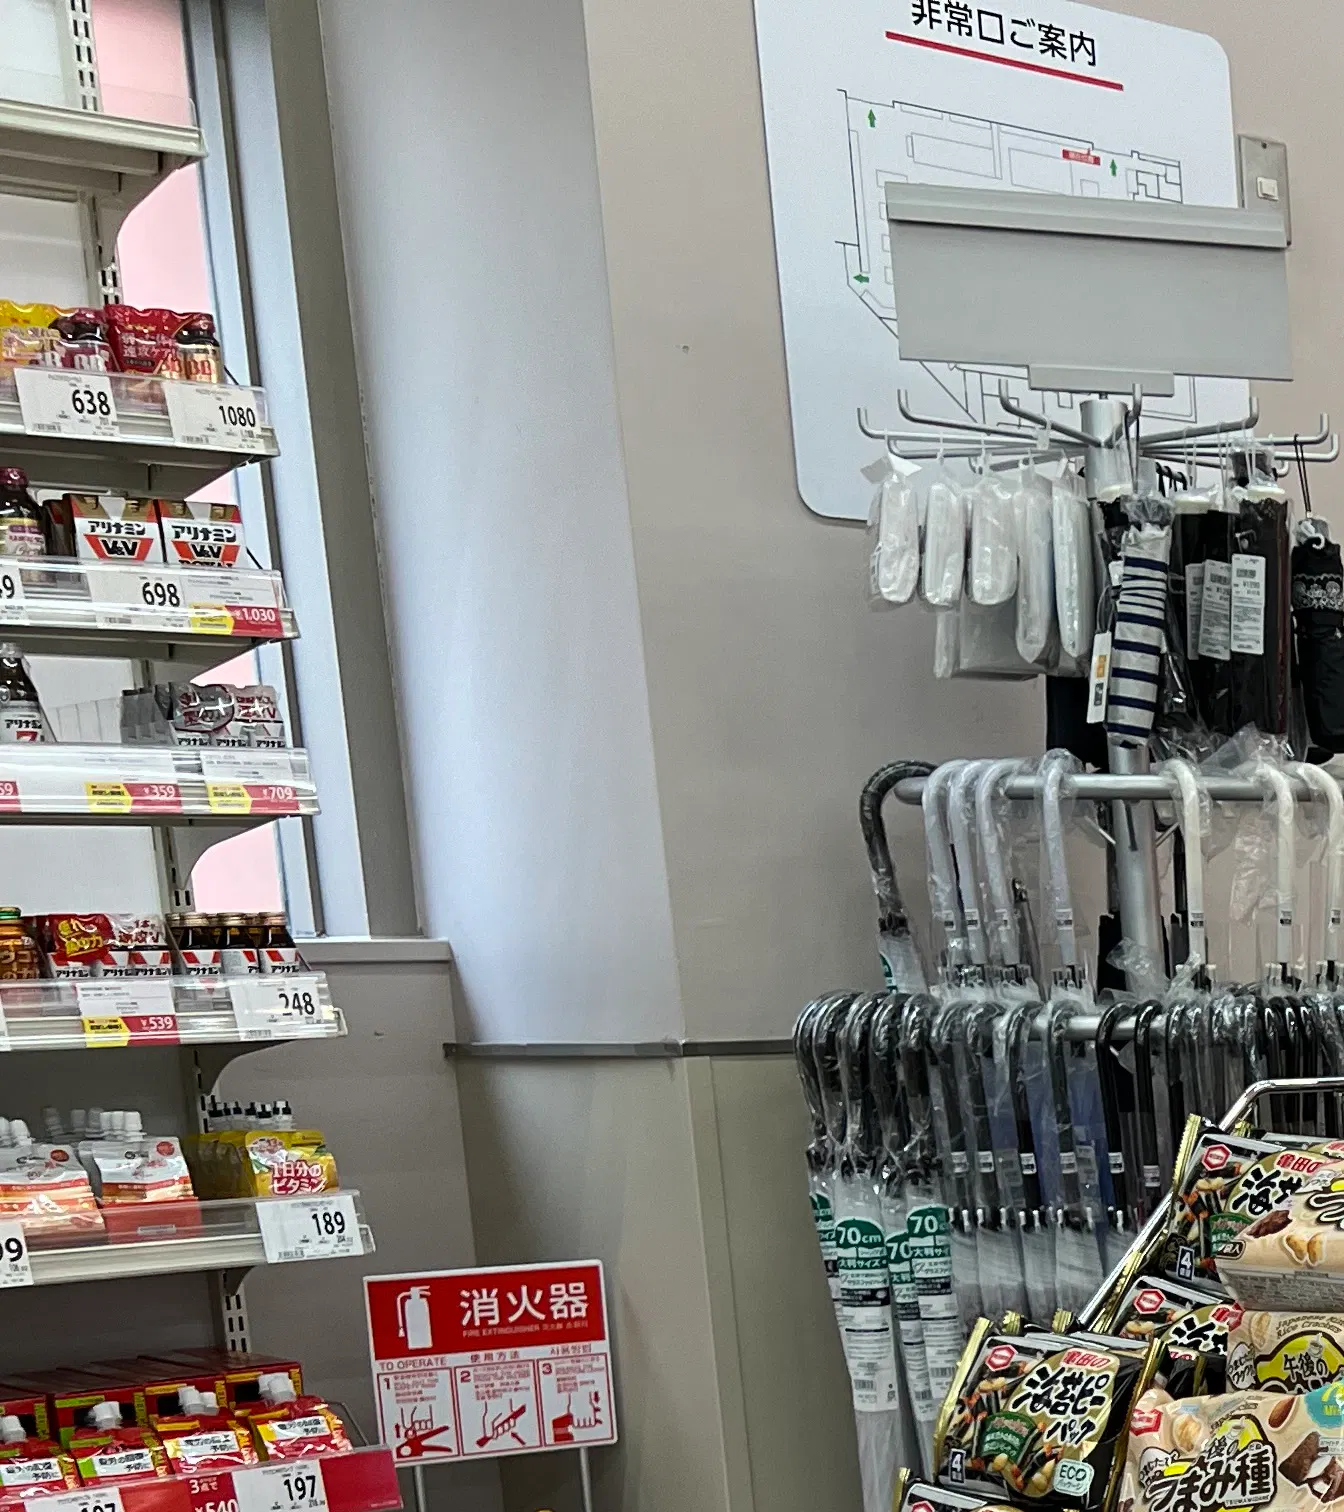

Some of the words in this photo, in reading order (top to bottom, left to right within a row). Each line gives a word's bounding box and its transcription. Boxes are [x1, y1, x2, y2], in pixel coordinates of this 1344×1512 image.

[912, 0, 1097, 67] 非常口ご案内
[72, 390, 111, 415] 638
[219, 405, 256, 427] 1080
[87, 520, 146, 536] アリナミン
[171, 525, 237, 541] アリナミン
[142, 582, 180, 607] 698
[271, 1162, 324, 1178] 1日分の
[269, 1177, 326, 1193] ビタミン
[311, 1211, 346, 1236] 189
[837, 1227, 883, 1246] 70cm
[460, 1282, 589, 1327] 消火器
[380, 1361, 395, 1372] TO
[397, 1356, 447, 1370] OPERATE
[1059, 1465, 1087, 1481] ECO
[283, 1475, 317, 1501] 197
